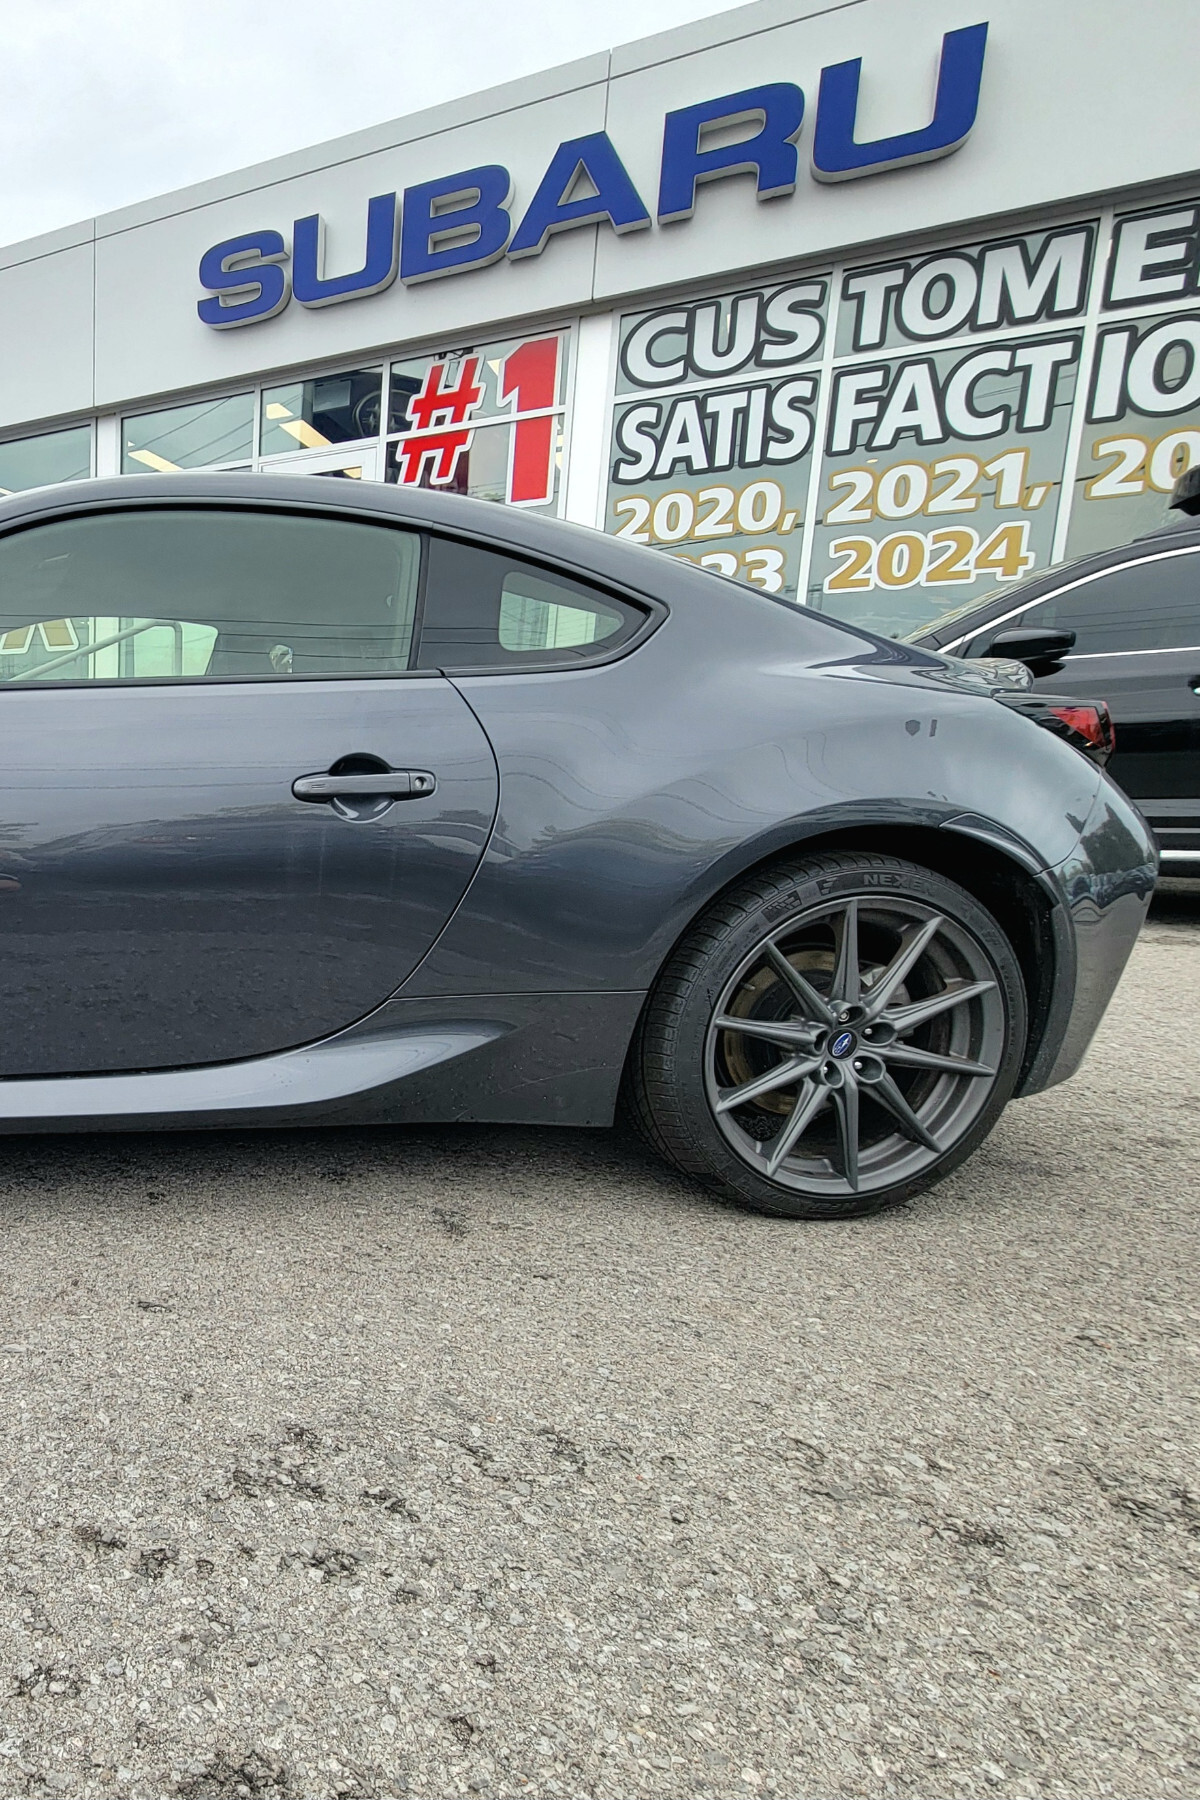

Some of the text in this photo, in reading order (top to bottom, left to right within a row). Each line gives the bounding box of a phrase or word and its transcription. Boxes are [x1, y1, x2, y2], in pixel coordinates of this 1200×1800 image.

[197, 22, 989, 330] SUBARU
[621, 205, 1200, 389] CUSTOME
[397, 334, 563, 507] #1
[614, 478, 800, 545] 2020,
[822, 448, 1052, 527] 2021,
[827, 521, 1036, 594] 2024
